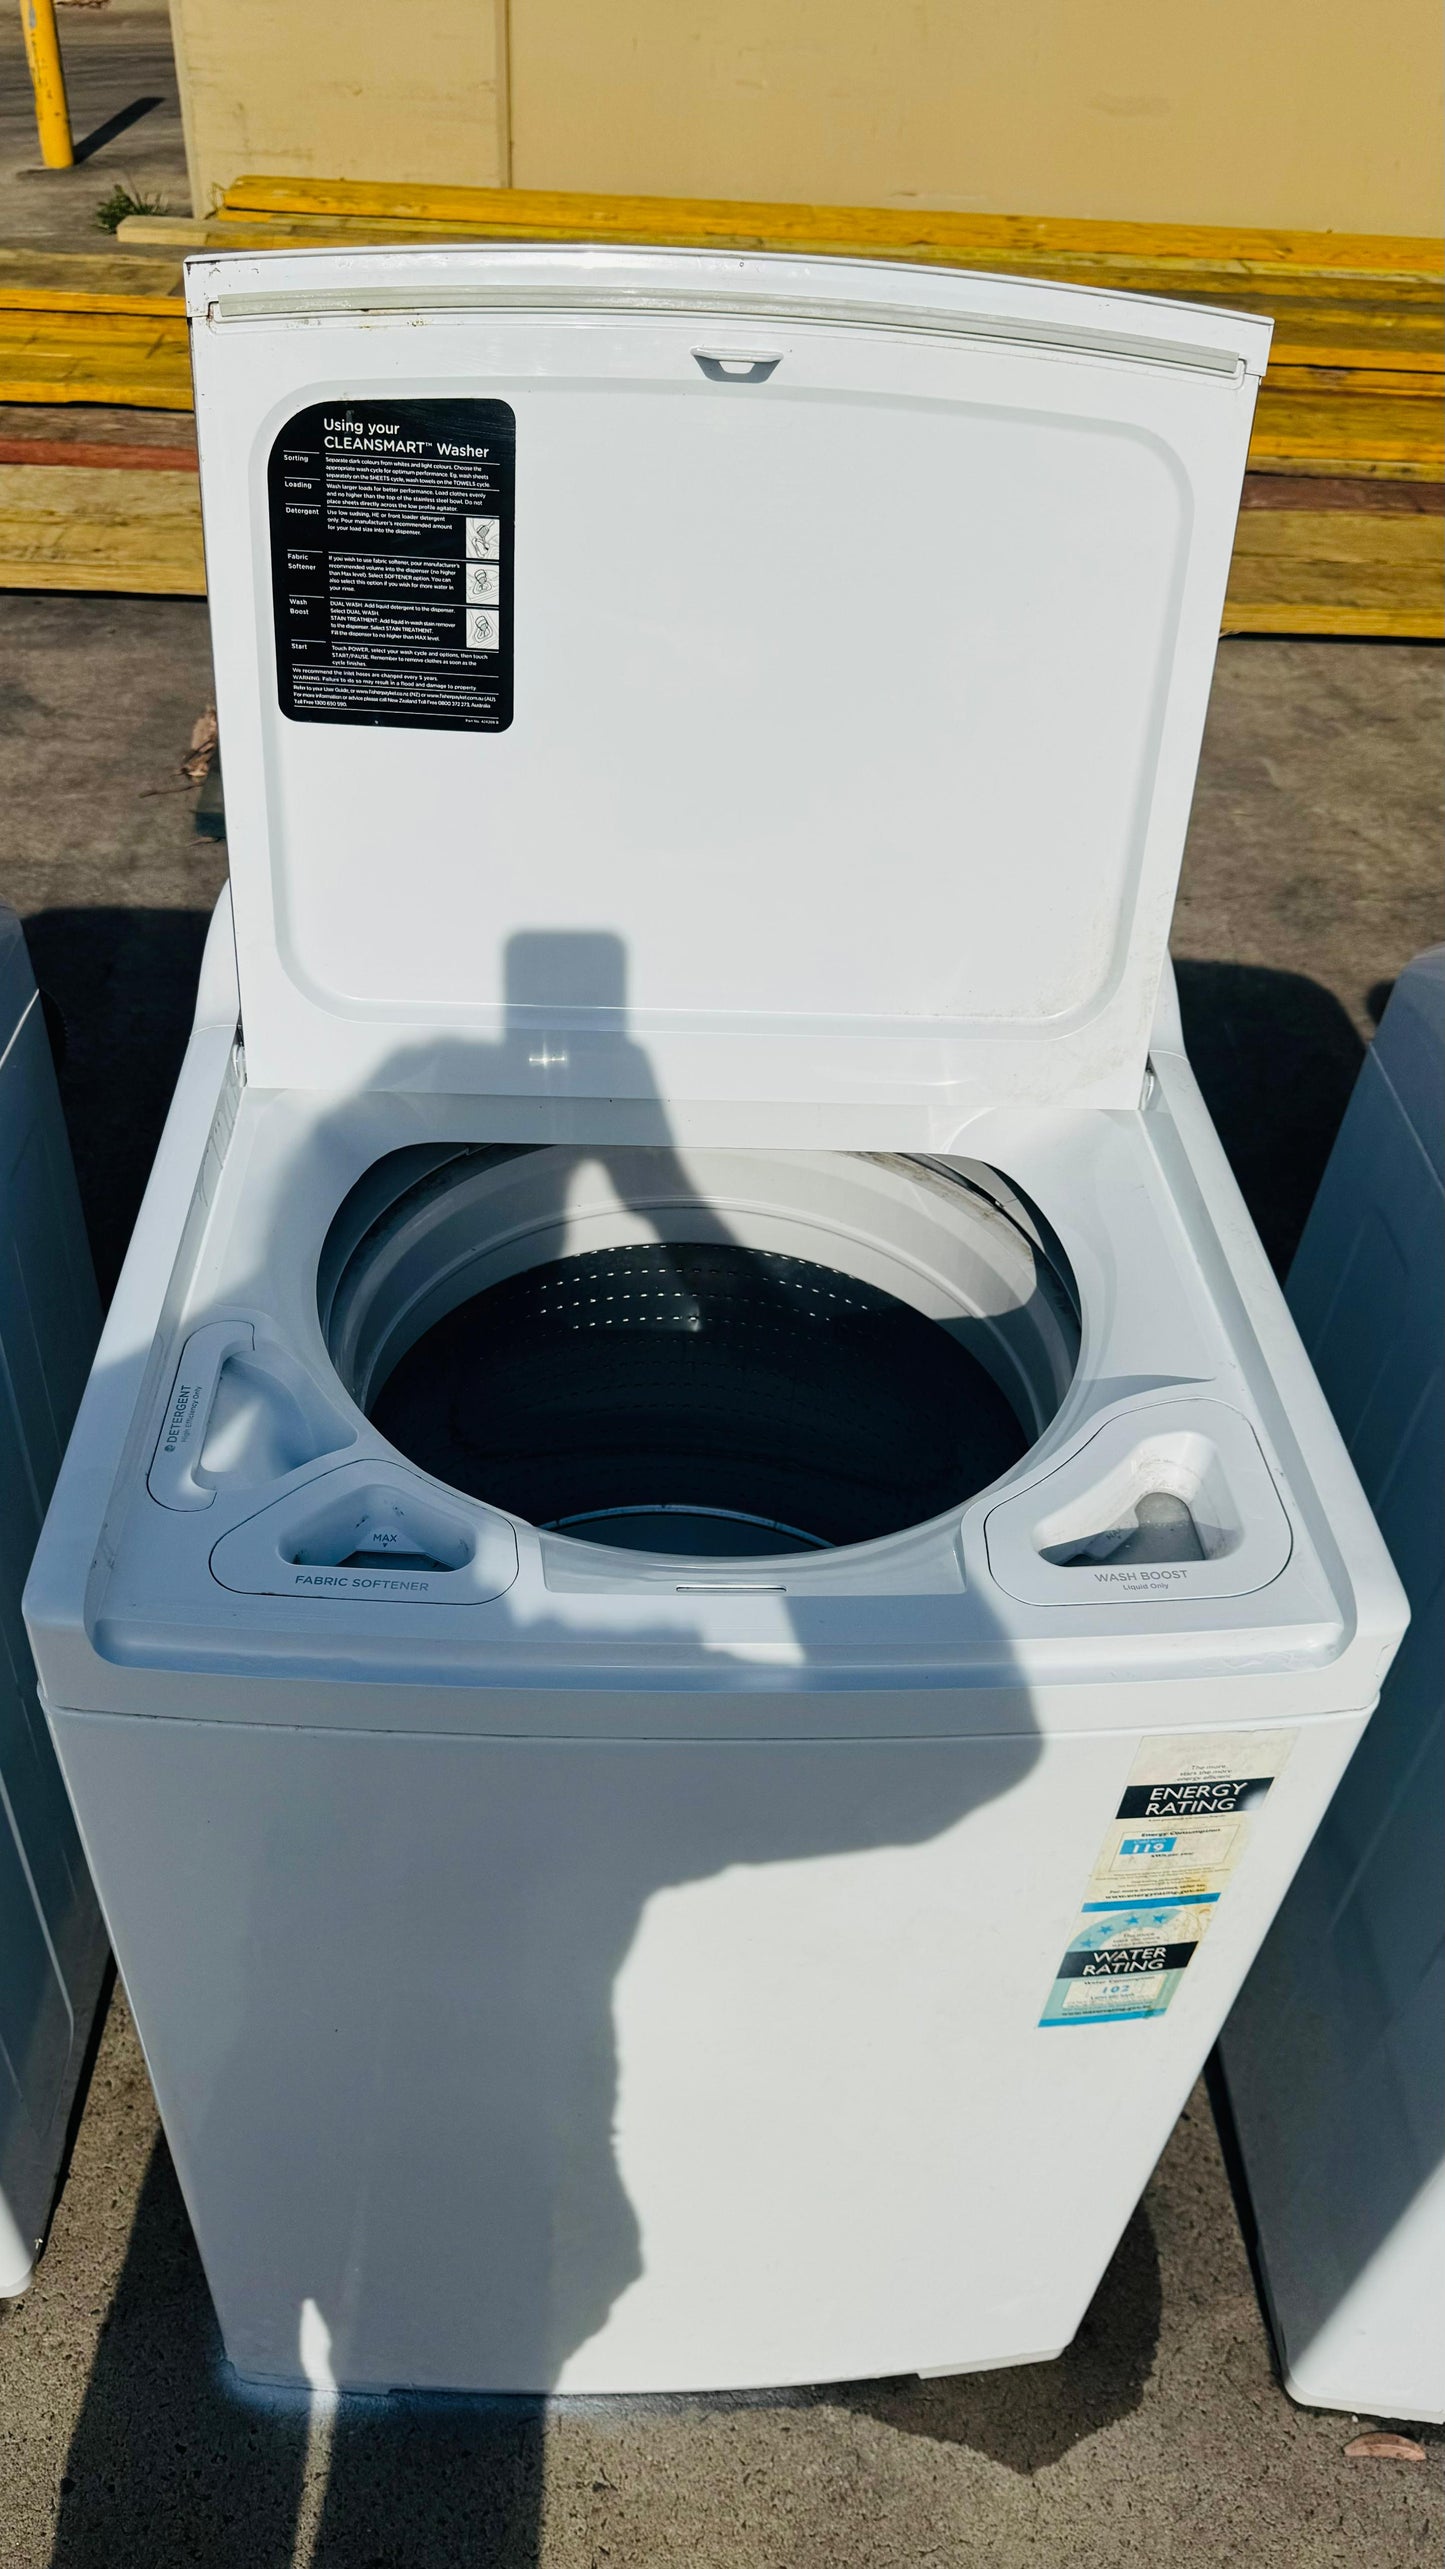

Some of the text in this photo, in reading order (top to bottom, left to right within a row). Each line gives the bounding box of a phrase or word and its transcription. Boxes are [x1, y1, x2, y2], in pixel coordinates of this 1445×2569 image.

[324, 418, 400, 435] Using your
[436, 442, 489, 458] Washer
[283, 454, 309, 463] Sorting
[284, 481, 312, 490] Loading
[286, 507, 319, 515] Detergent
[193, 1386, 202, 1400] Only
[166, 1385, 191, 1443] DETERGENT
[373, 1534, 398, 1542] MAX
[1094, 1570, 1188, 1582] WASH BOOST
[296, 1576, 429, 1591] FABRIC SOFTENER
[1150, 1782, 1248, 1801] ENERGY
[1145, 1798, 1236, 1816] RATING
[1132, 1843, 1164, 1854] 119
[1094, 1947, 1166, 1962] WATER
[1082, 1960, 1164, 1976] RATING
[1102, 1985, 1130, 1994] 102
